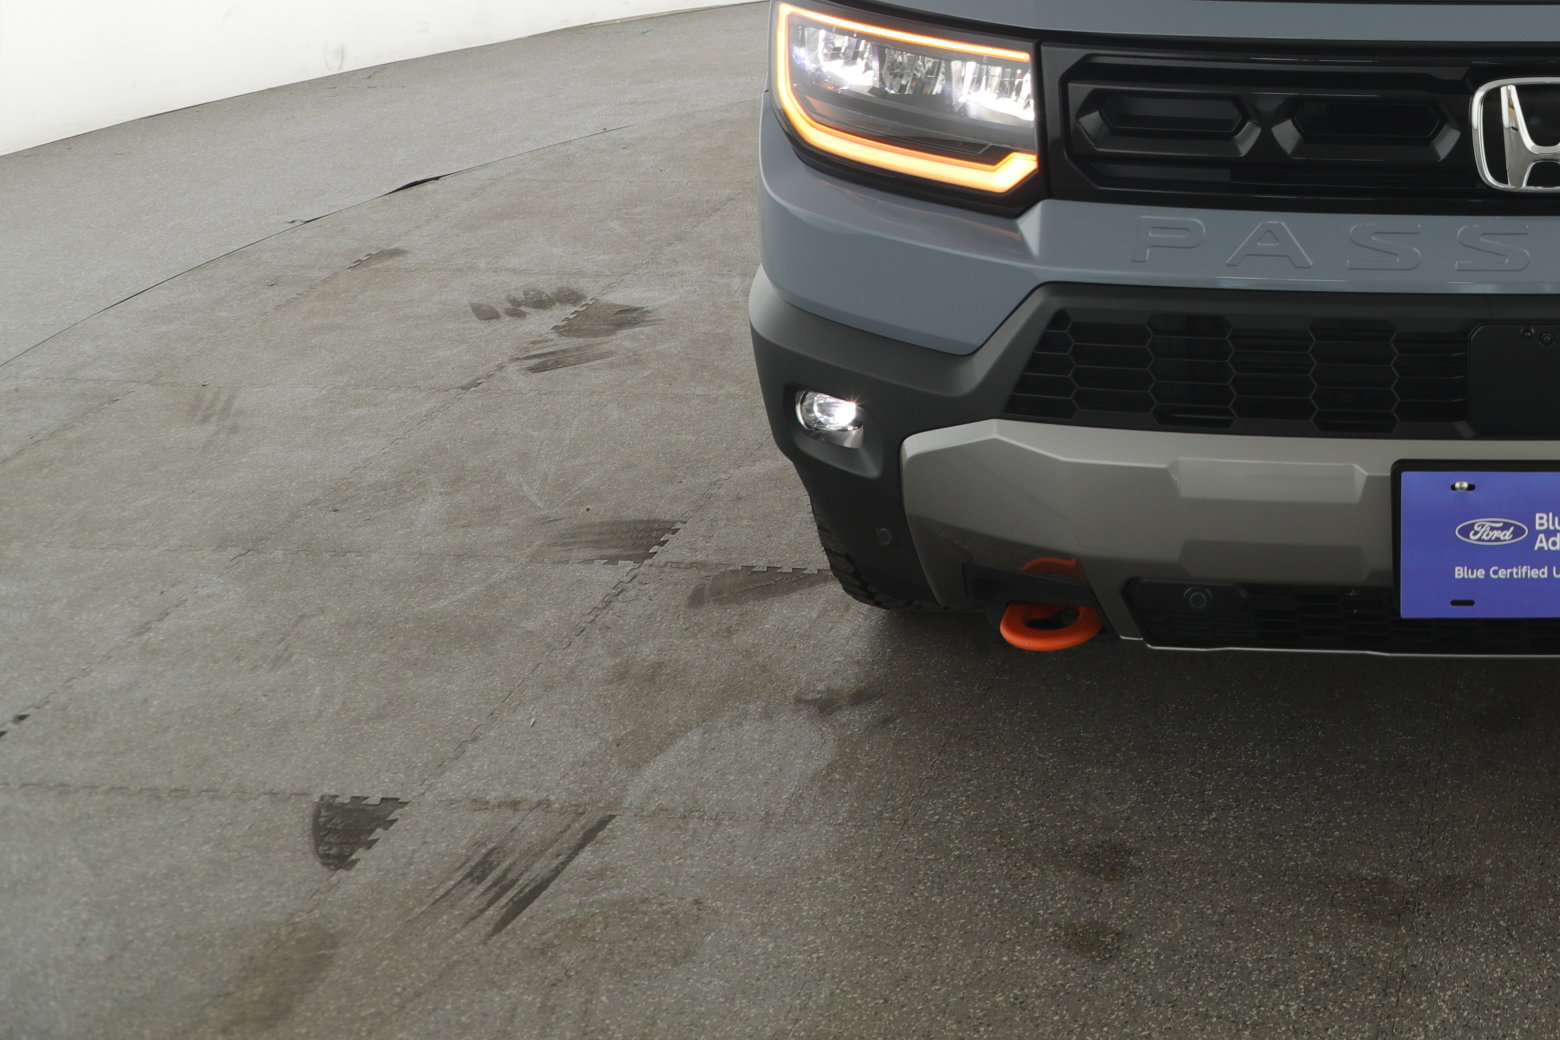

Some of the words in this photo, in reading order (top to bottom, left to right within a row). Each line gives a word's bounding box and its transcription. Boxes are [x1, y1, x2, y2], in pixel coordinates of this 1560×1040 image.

[1469, 521, 1514, 541] Ford
[1454, 566, 1486, 579] Blue
[1489, 565, 1548, 579] Certified
